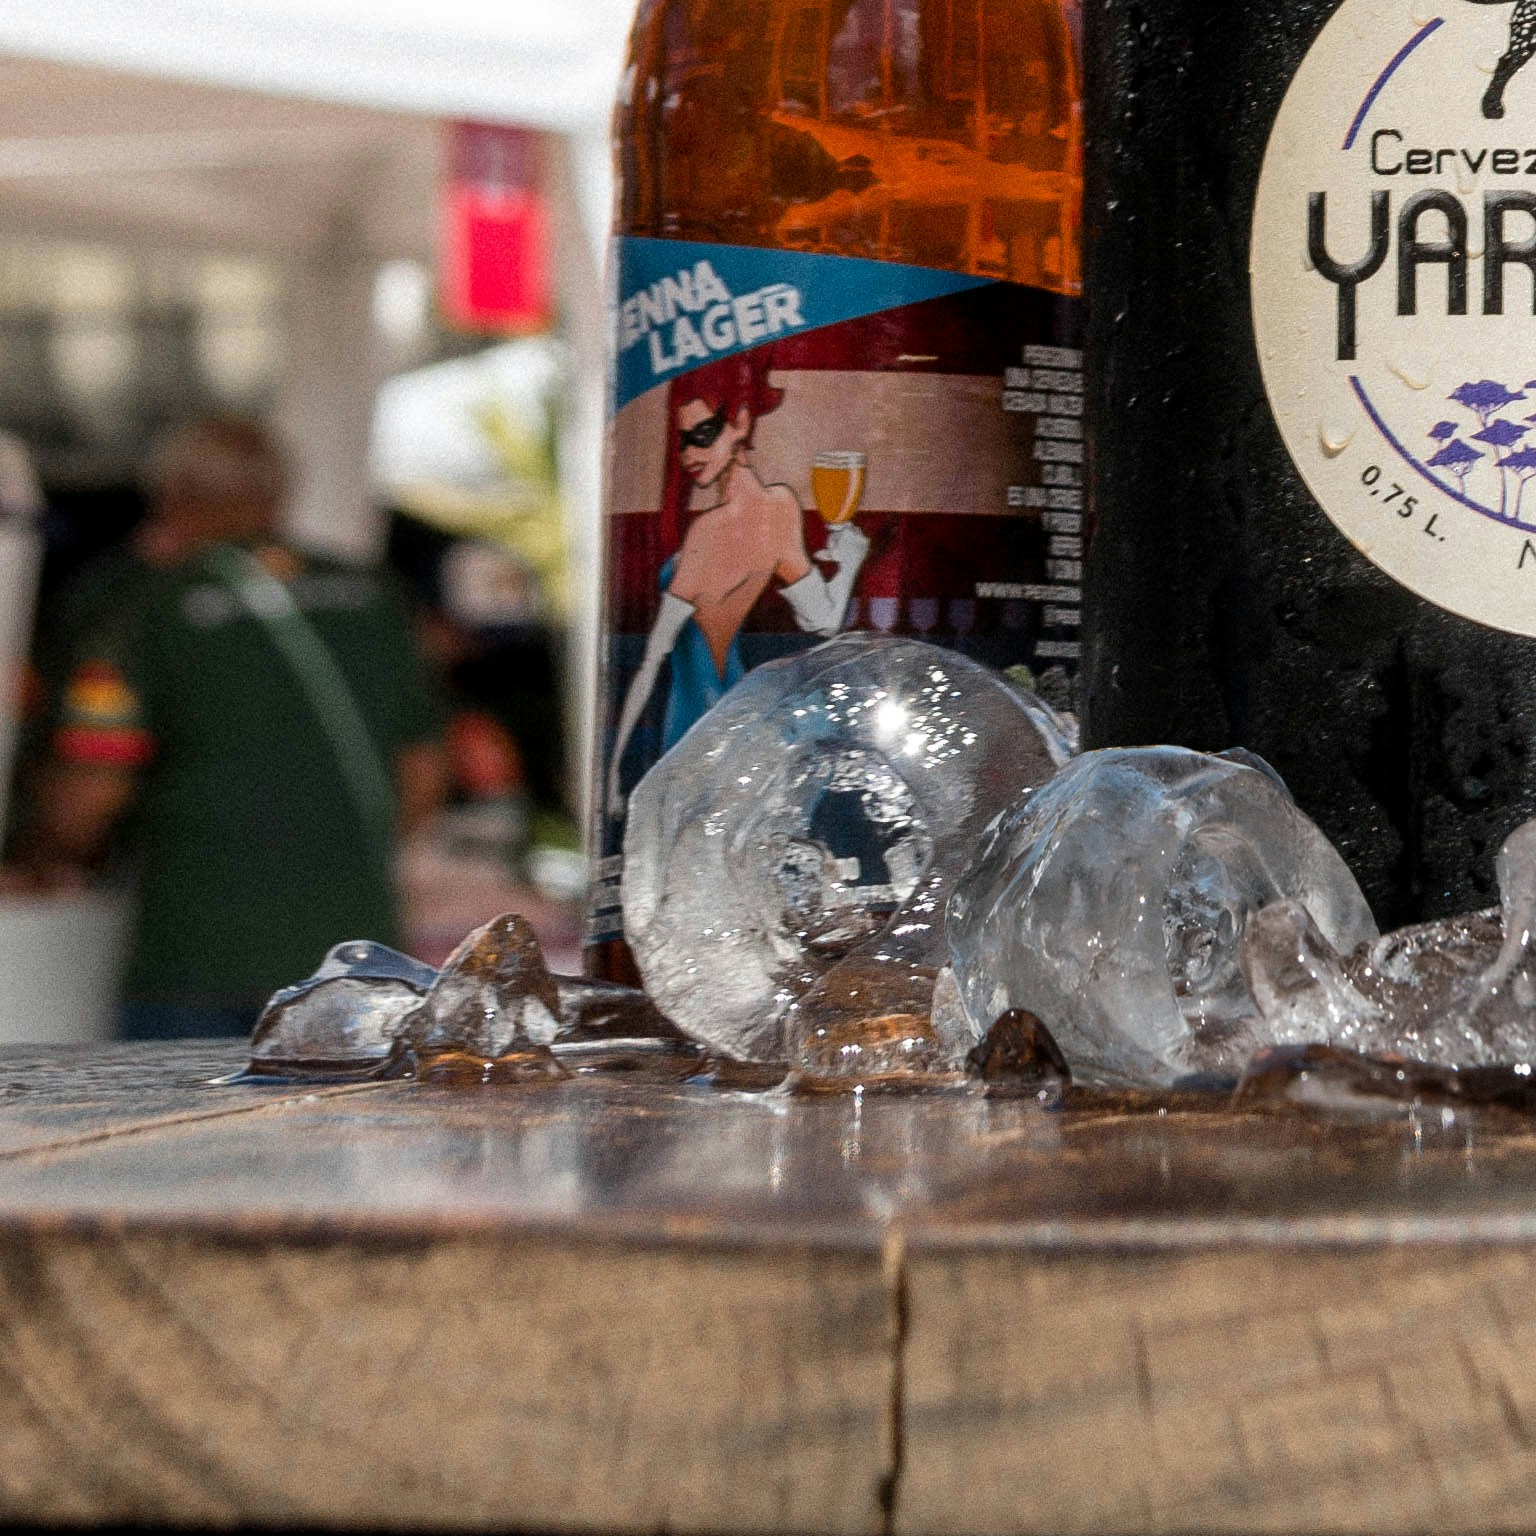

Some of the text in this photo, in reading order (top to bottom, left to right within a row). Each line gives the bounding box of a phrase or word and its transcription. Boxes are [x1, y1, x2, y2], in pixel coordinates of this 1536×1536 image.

[620, 259, 732, 351] ENNA
[650, 283, 806, 374] LAGER
[1362, 465, 1446, 542] 0,75 L.
